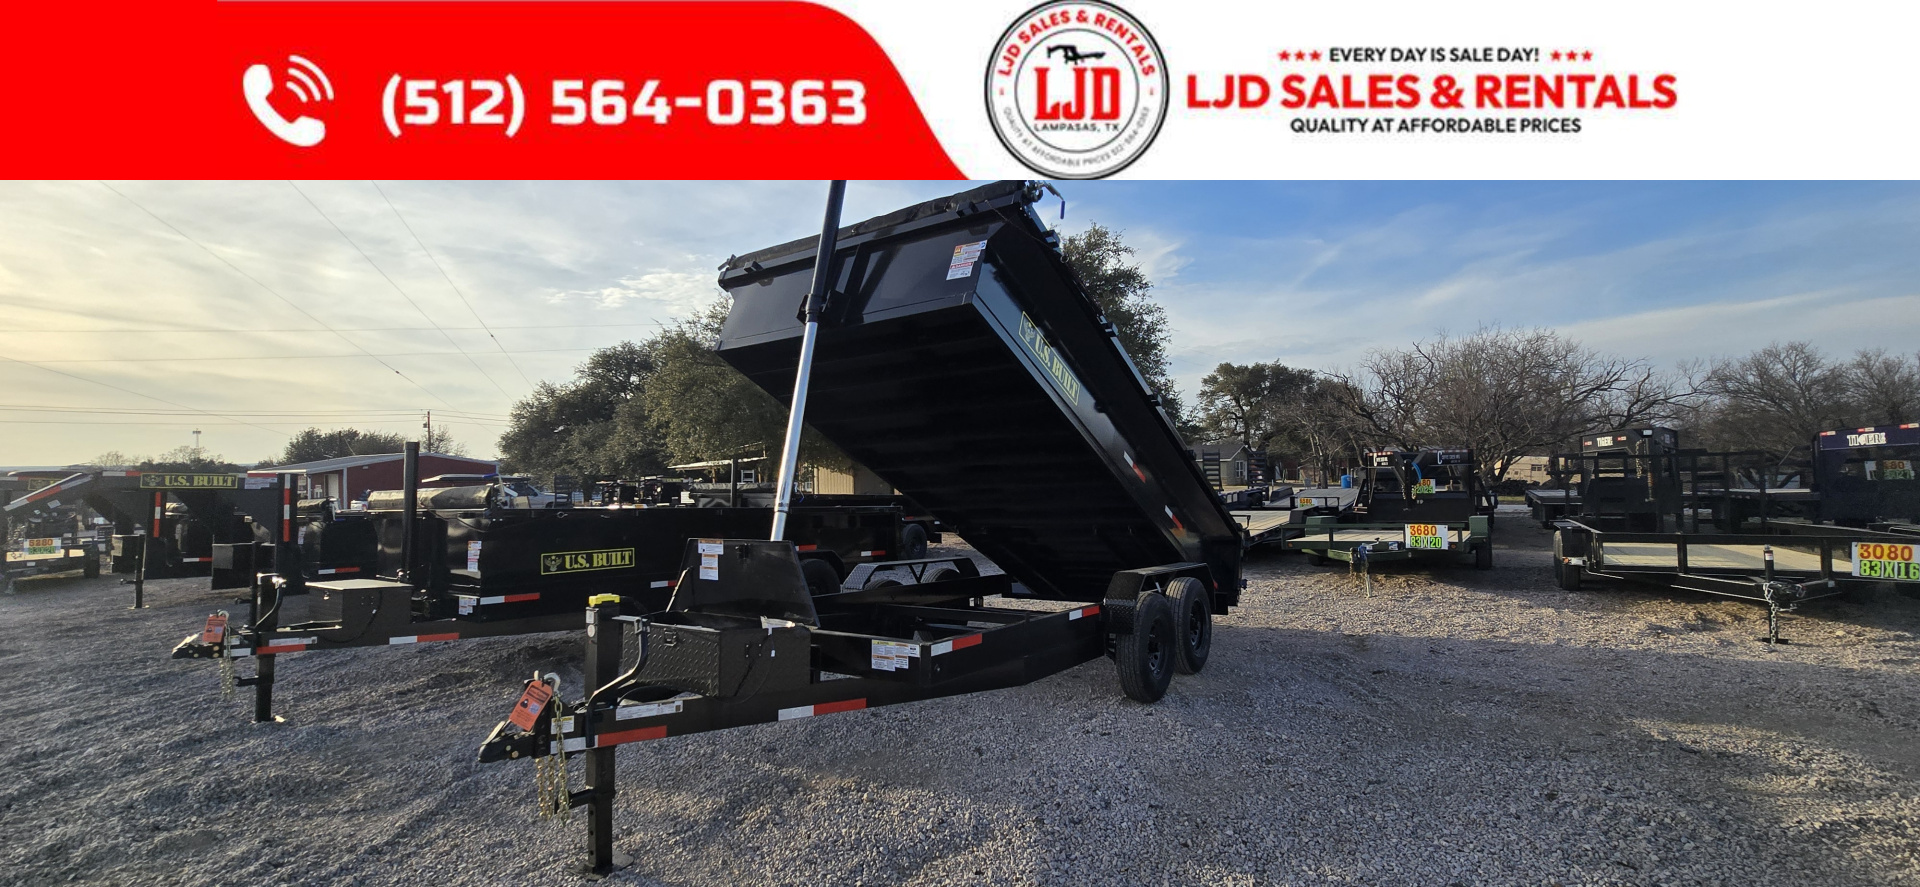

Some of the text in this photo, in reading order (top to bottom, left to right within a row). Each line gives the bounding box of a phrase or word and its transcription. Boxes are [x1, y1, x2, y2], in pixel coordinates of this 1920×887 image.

[1034, 333, 1078, 398] U.S. BUILT
[164, 475, 190, 487] U.S.
[193, 475, 235, 487] BUILT
[1409, 525, 1438, 536] 3680
[564, 550, 632, 570] U.S. BUILT
[1859, 543, 1913, 562] 3080
